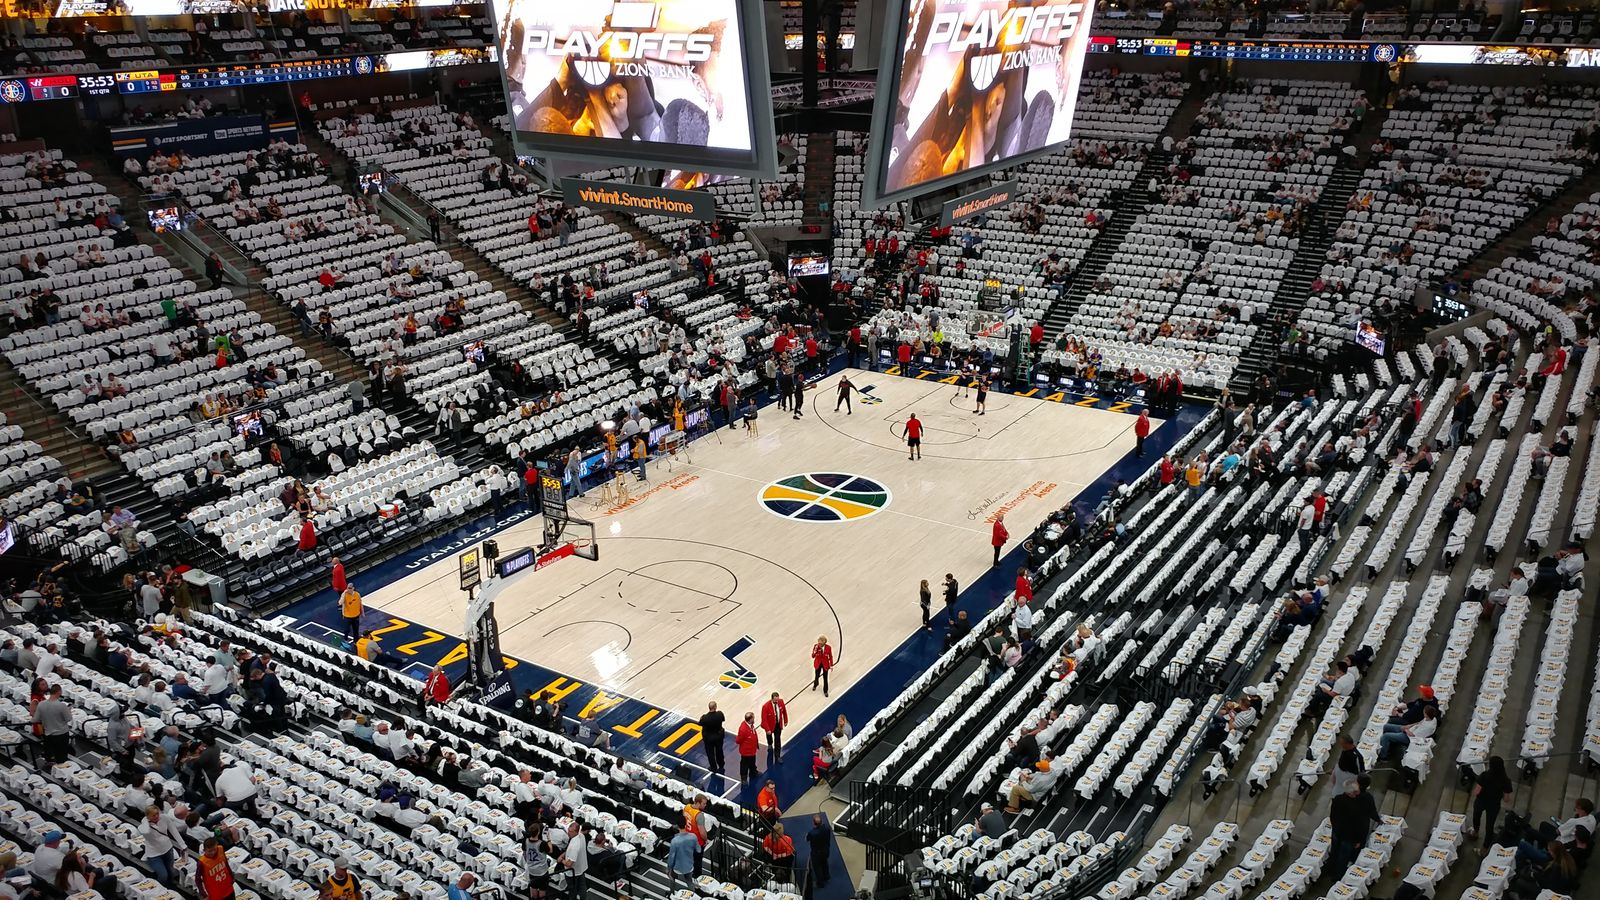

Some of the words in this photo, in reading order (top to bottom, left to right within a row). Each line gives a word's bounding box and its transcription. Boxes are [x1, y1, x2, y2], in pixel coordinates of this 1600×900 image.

[923, 3, 1084, 56] PLAYOFFS
[523, 30, 715, 62] PLAYOFFS
[1116, 39, 1142, 48] 35:53
[1003, 50, 1033, 70] ZIONS
[1036, 45, 1062, 64] BANK
[616, 62, 657, 78] ZIONS
[660, 64, 700, 80] BANK
[79, 76, 114, 88] 35:53
[128, 82, 134, 91] 0
[61, 87, 70, 96] 0
[579, 187, 694, 214] vivint.SmartHome
[952, 192, 1008, 219] vivint.SmartHome
[1013, 388, 1132, 412] JAZZ
[542, 478, 561, 489] 35:53
[670, 475, 700, 490] Arena
[1033, 482, 1058, 498] Arena
[405, 508, 533, 570] UTAHJAZZ.COM
[510, 554, 530, 571] PLAYOFFS
[370, 618, 518, 669] AZZ
[479, 682, 511, 706] SPALDING
[529, 676, 704, 755] UTAH
[528, 850, 540, 862] 12
[209, 861, 226, 876] UTAH
[216, 870, 226, 882] 45
